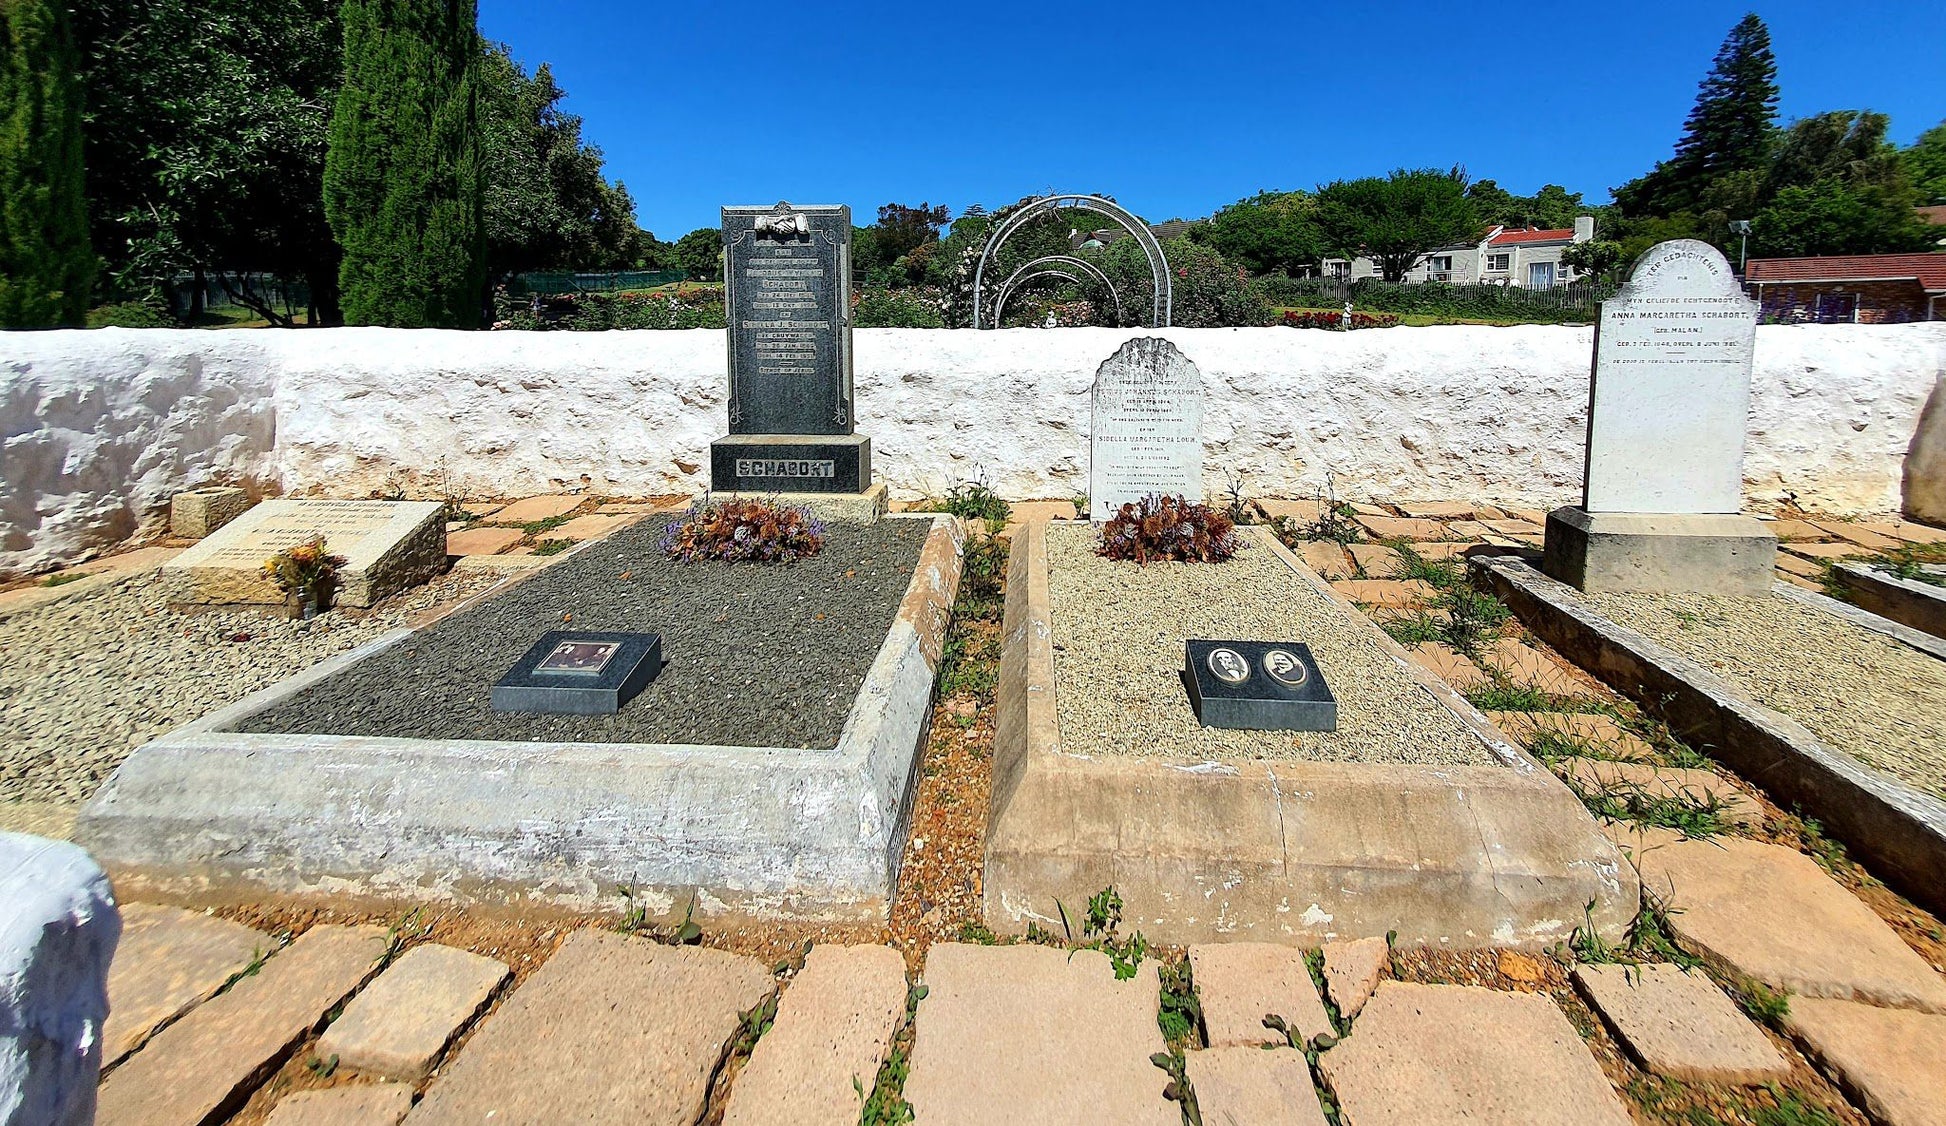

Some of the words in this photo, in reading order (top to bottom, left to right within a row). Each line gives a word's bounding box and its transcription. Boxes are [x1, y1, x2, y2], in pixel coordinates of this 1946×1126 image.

[1647, 262, 1661, 277] TER
[1664, 252, 1718, 276] GEDACHTENIS
[739, 461, 832, 476] SCHABORT
